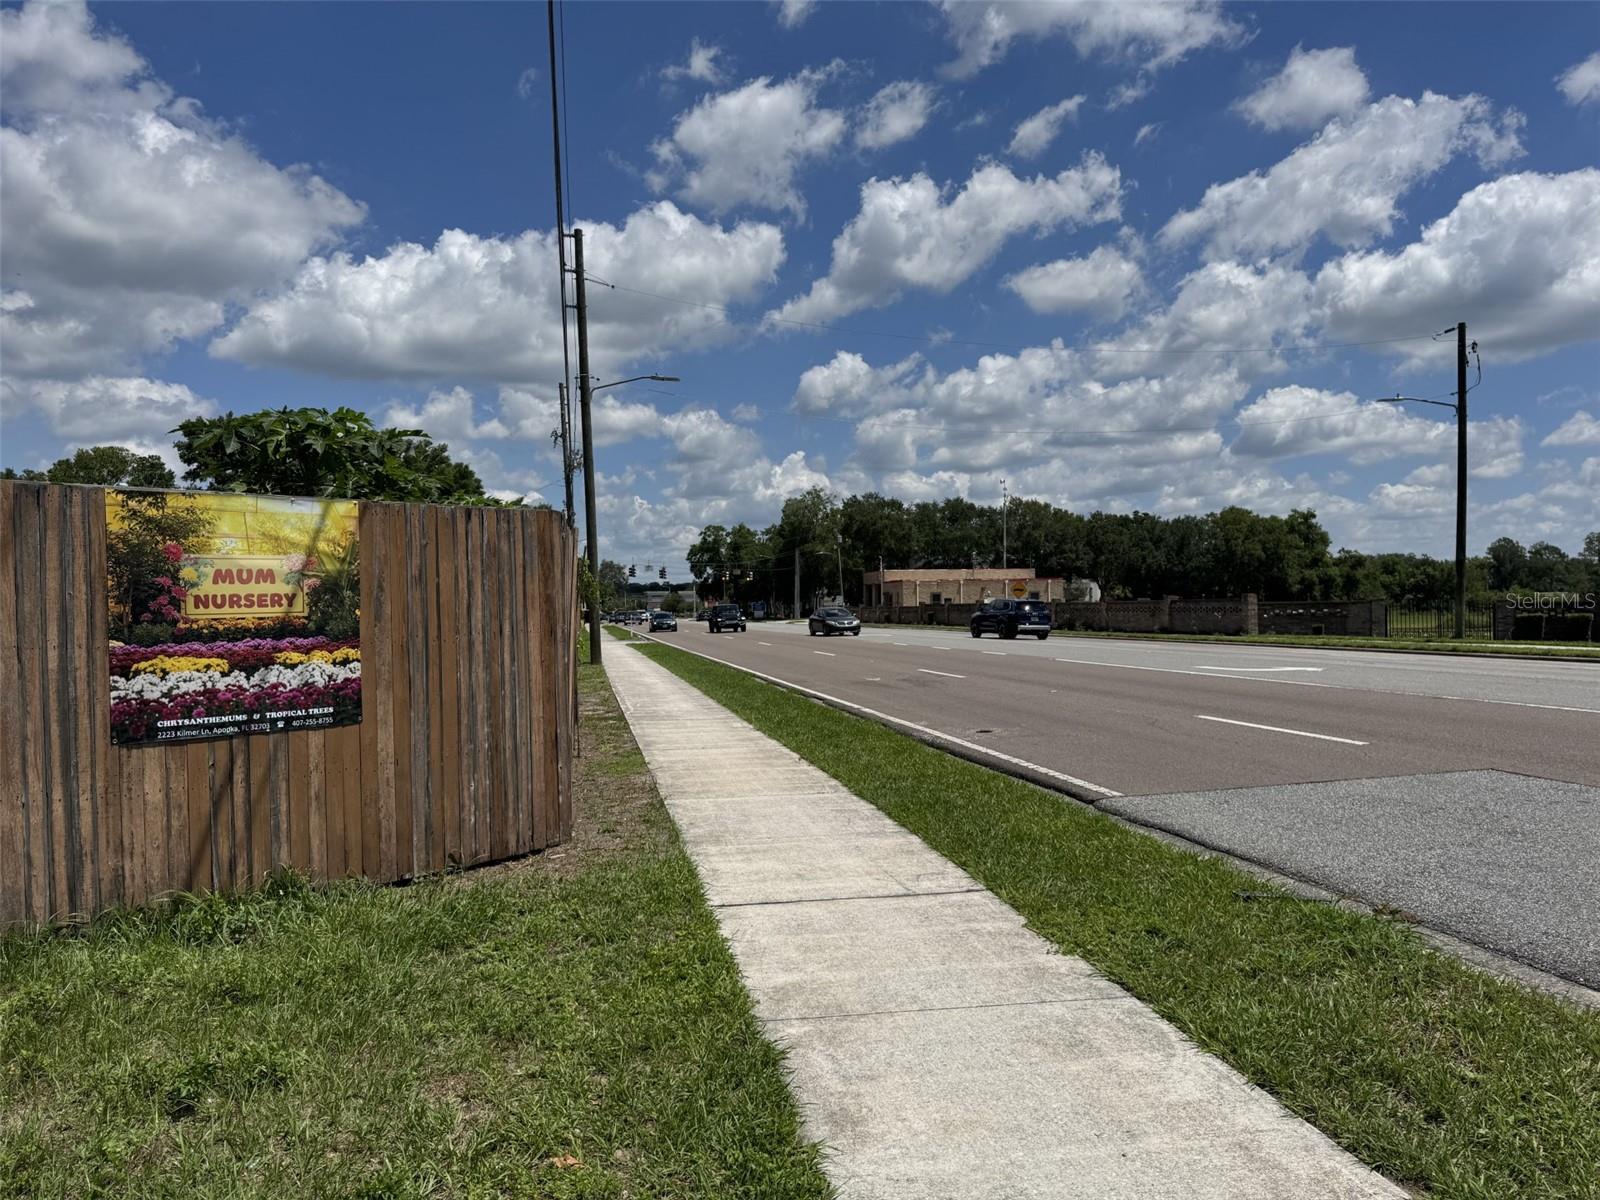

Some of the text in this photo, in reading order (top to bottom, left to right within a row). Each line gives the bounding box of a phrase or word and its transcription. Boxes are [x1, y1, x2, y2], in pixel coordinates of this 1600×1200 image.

[212, 568, 276, 585] MUM
[193, 592, 297, 609] NURSERY
[157, 714, 248, 728] CHRYSANTHEMUMS
[265, 709, 308, 719] TROPICAL
[308, 706, 334, 715] TREES
[157, 730, 176, 739] 2223
[177, 729, 200, 737] Kilmer
[201, 727, 212, 735] Ln,
[213, 725, 241, 735] Apopka,
[250, 723, 271, 731] 32703
[291, 717, 334, 727] 407-255-8755
